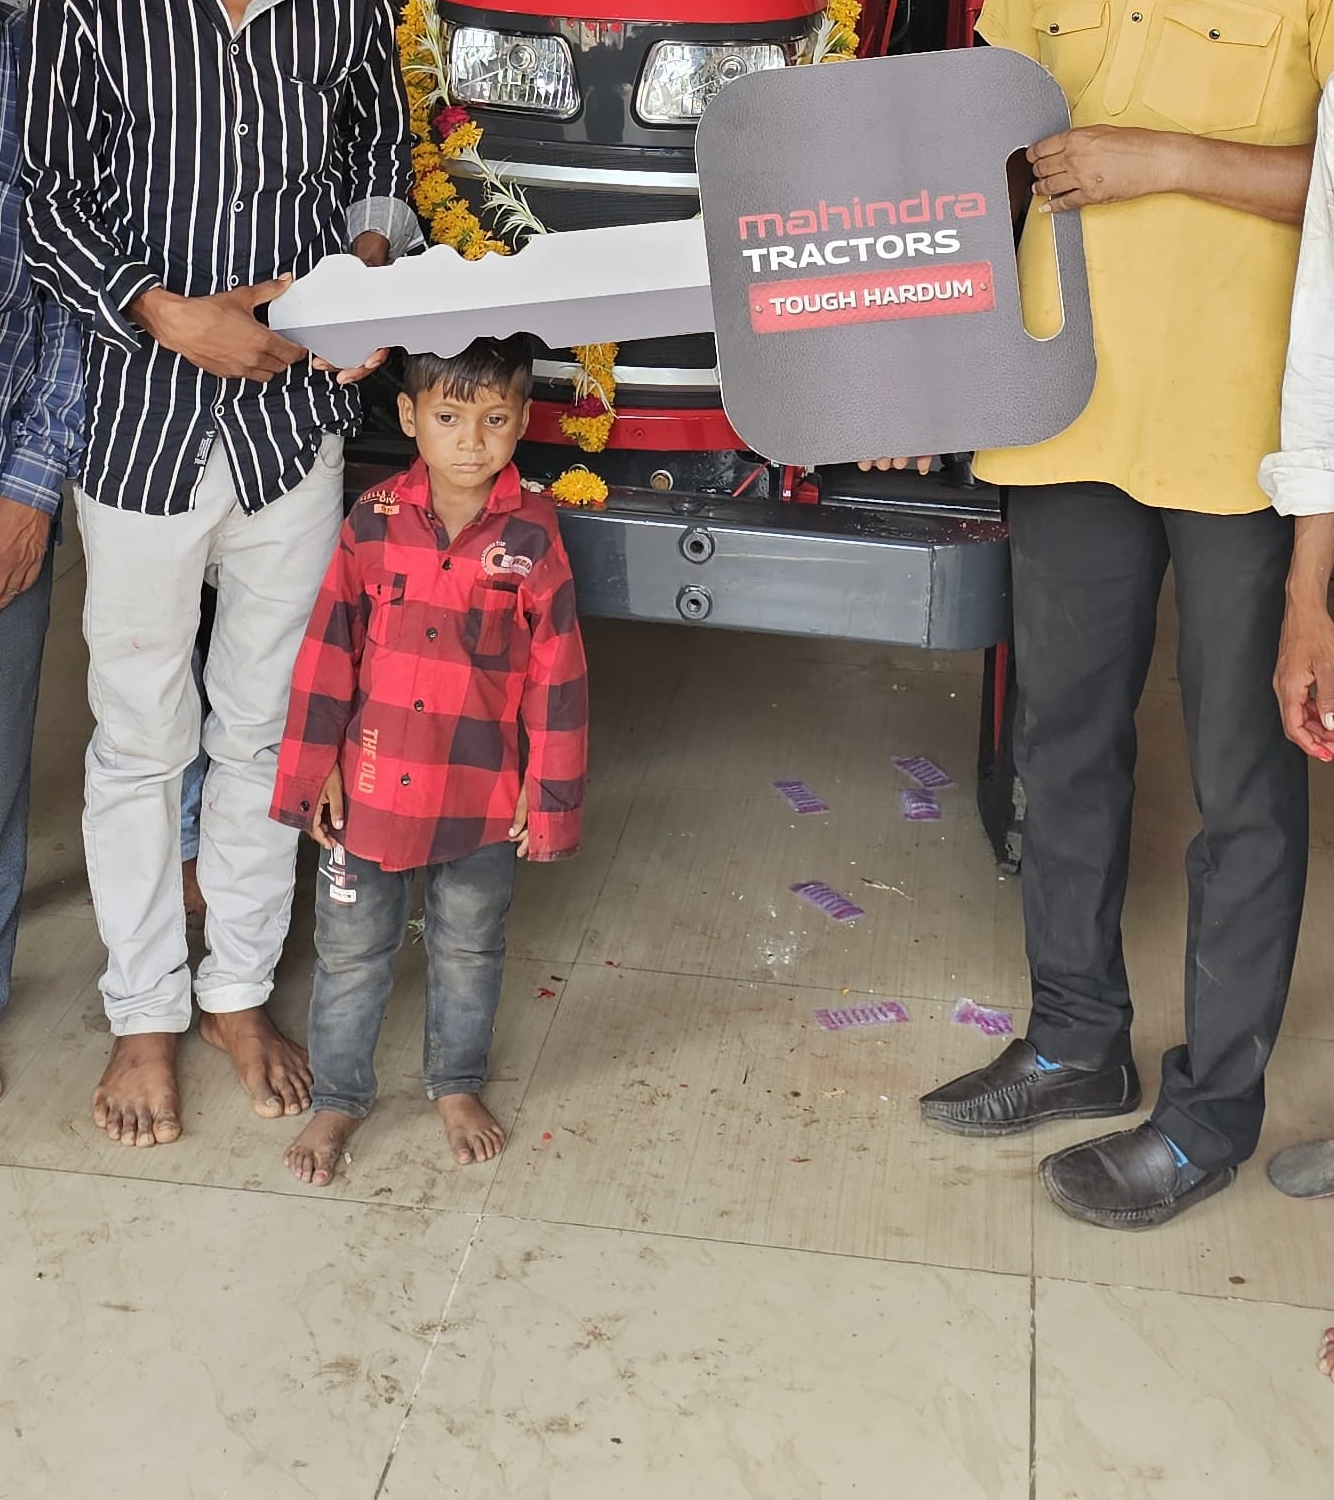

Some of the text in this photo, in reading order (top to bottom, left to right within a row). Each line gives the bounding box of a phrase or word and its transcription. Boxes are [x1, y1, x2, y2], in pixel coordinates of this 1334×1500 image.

[738, 189, 987, 241] mahindra
[742, 229, 961, 273] TRACTORS
[769, 278, 974, 317] TOUGH HARDUM
[362, 728, 379, 761] THE
